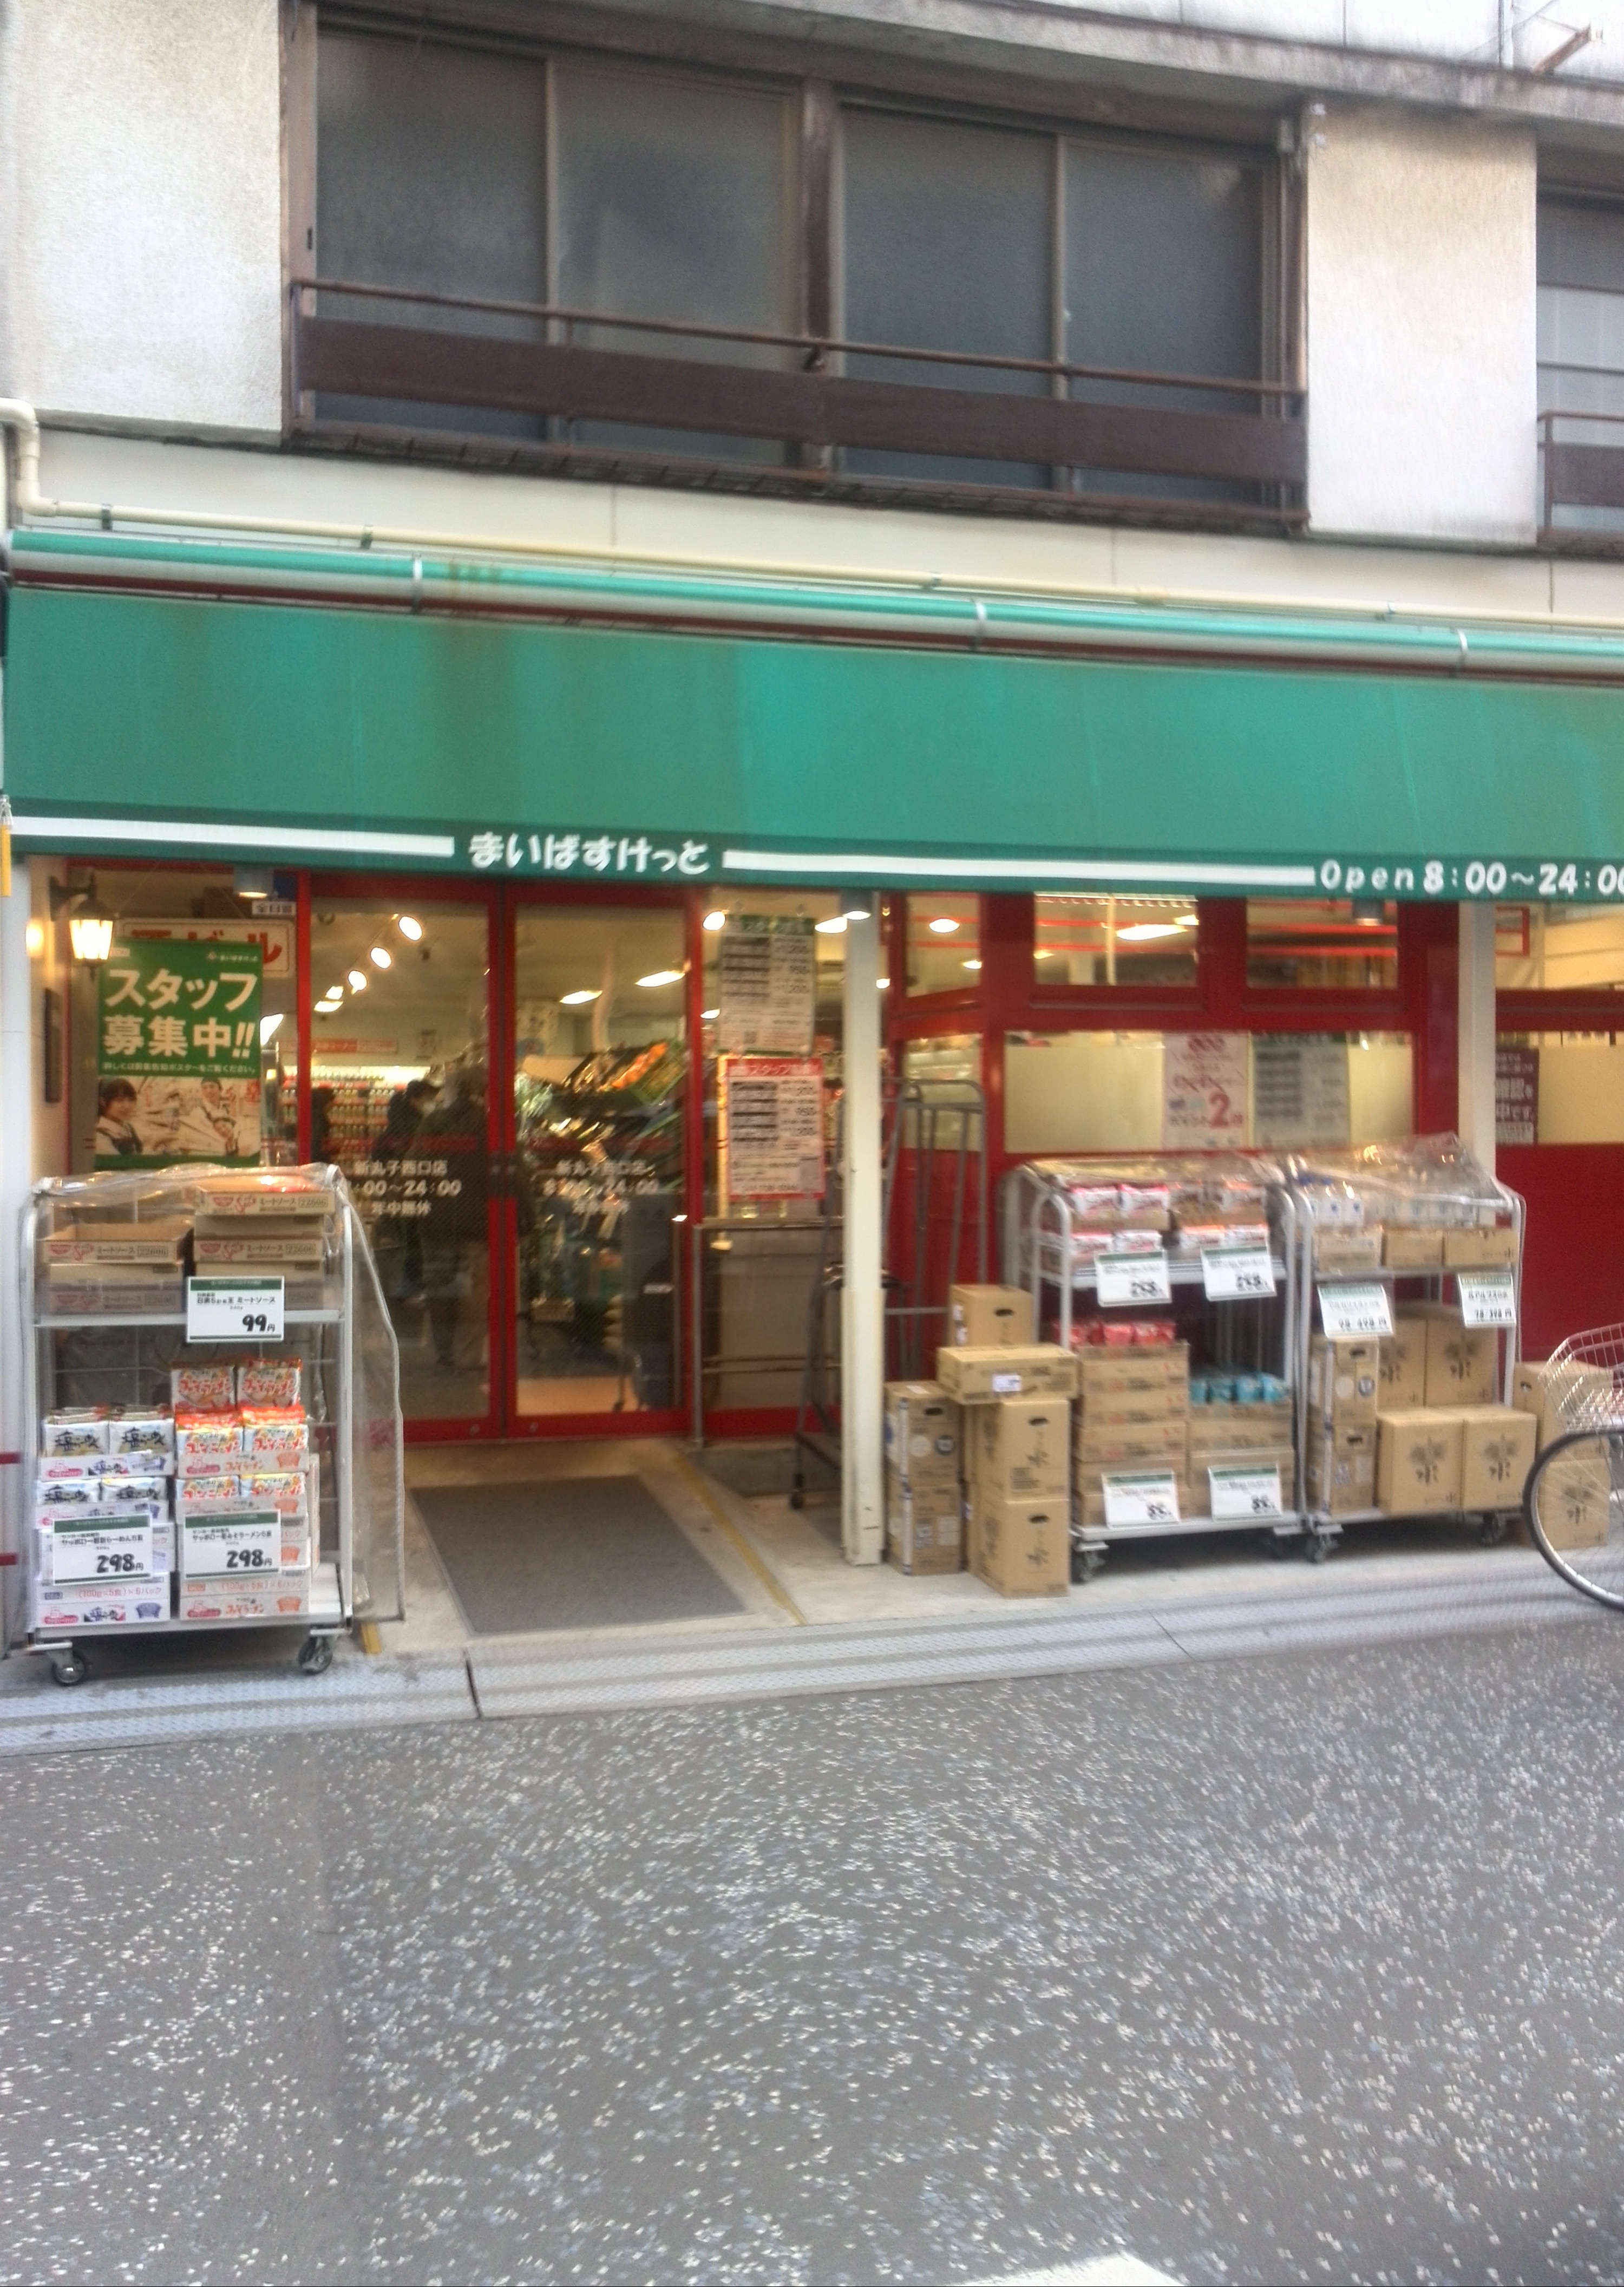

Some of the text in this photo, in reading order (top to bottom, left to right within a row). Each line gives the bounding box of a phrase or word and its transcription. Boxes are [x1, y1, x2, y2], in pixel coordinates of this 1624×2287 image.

[469, 832, 710, 875] まいばすけっと
[105, 968, 258, 1012] スタッフ
